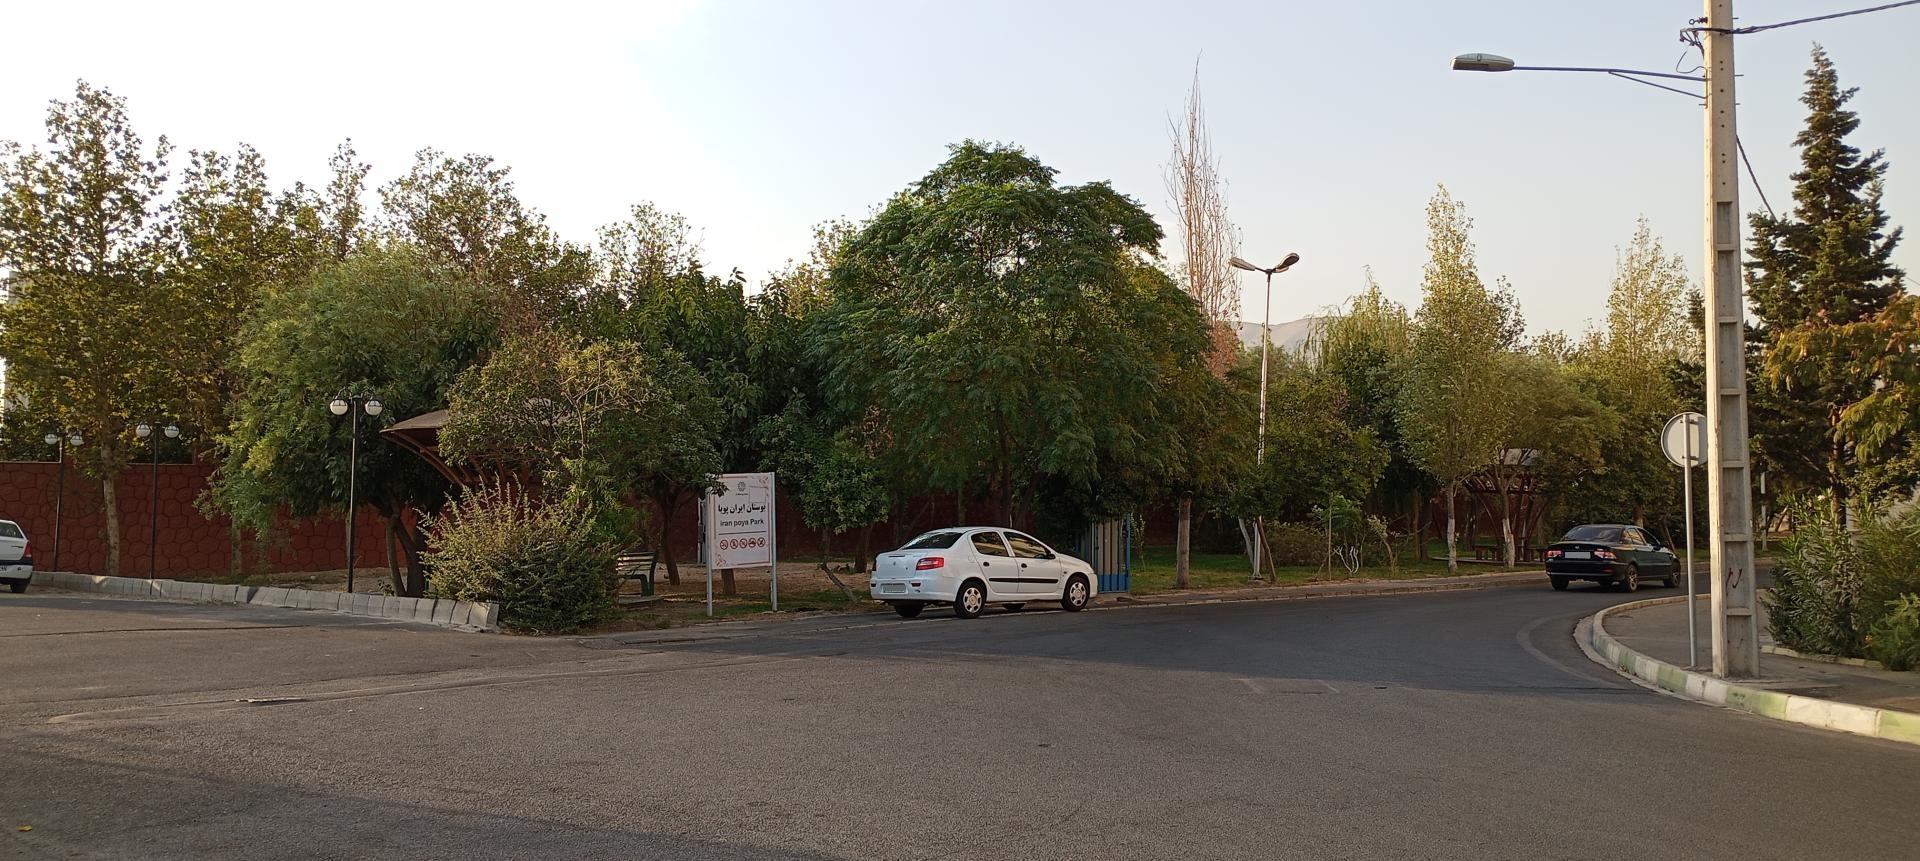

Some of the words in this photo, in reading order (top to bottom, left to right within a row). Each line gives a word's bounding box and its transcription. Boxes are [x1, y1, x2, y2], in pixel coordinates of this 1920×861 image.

[718, 504, 729, 515] پویا
[729, 503, 746, 514] ایران
[746, 503, 766, 514] بوستان
[733, 519, 749, 528] poya
